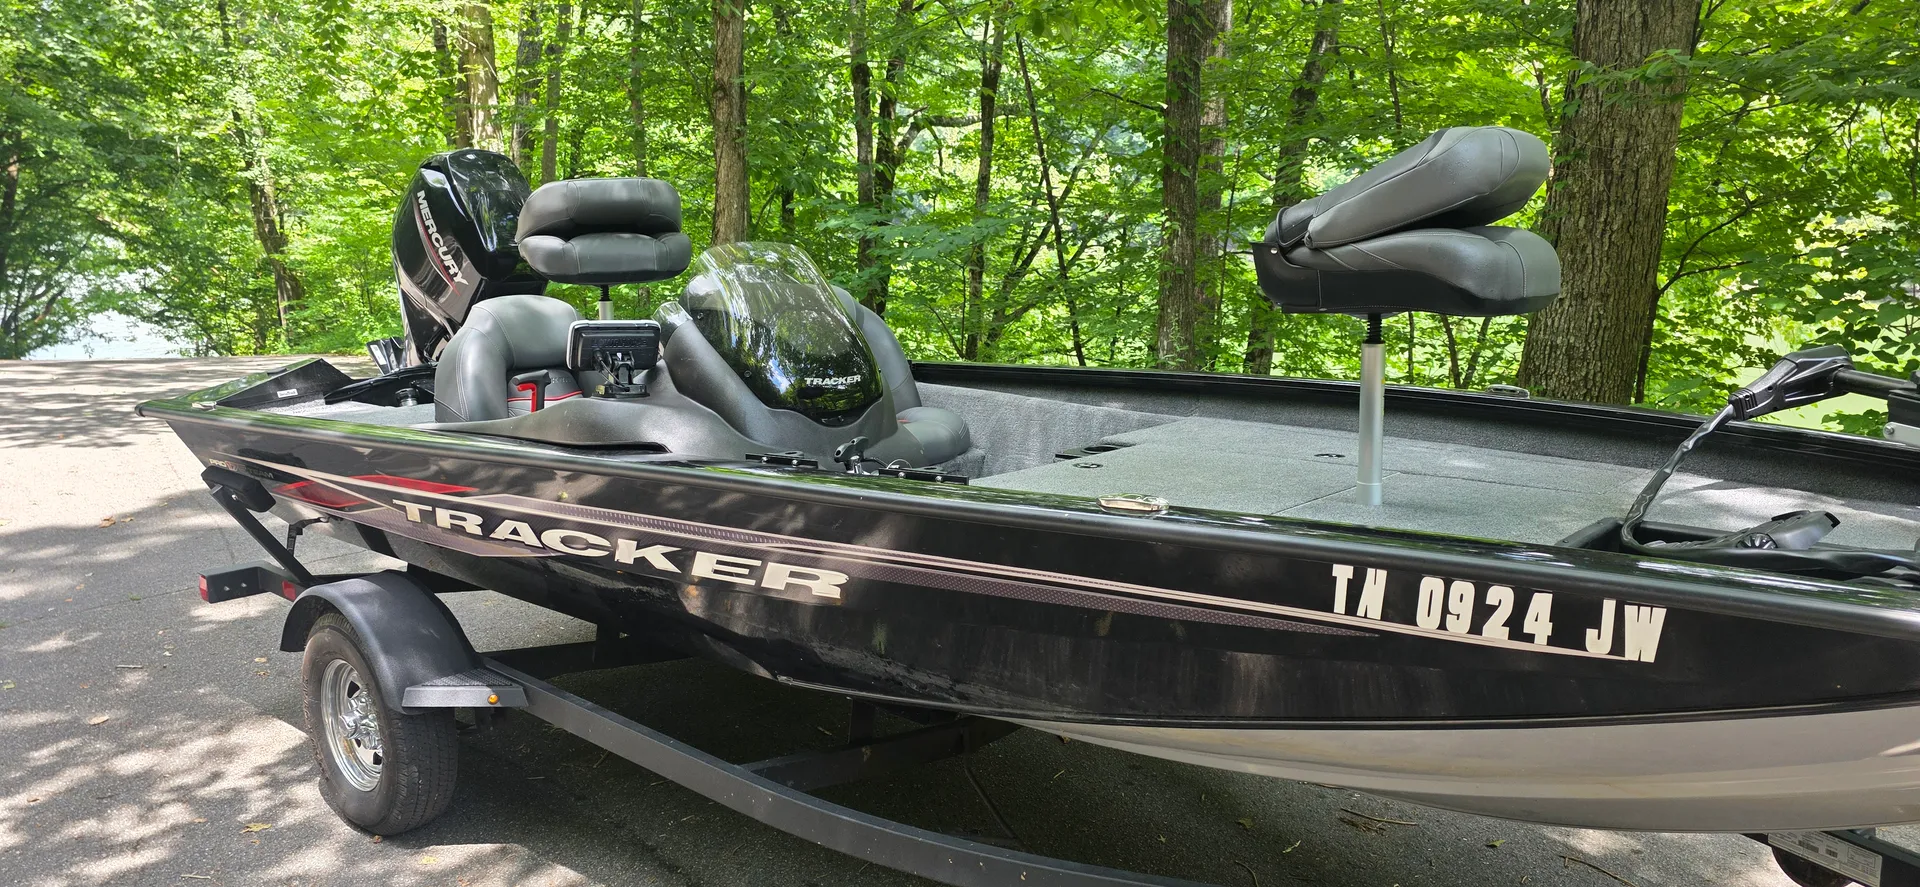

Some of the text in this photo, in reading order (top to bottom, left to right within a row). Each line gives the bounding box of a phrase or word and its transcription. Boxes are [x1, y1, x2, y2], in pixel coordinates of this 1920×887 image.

[417, 190, 468, 285] MERCURY
[804, 375, 861, 385] TRACKER
[393, 499, 849, 598] TRACKER
[1332, 564, 1667, 663] TN 0924 JW
